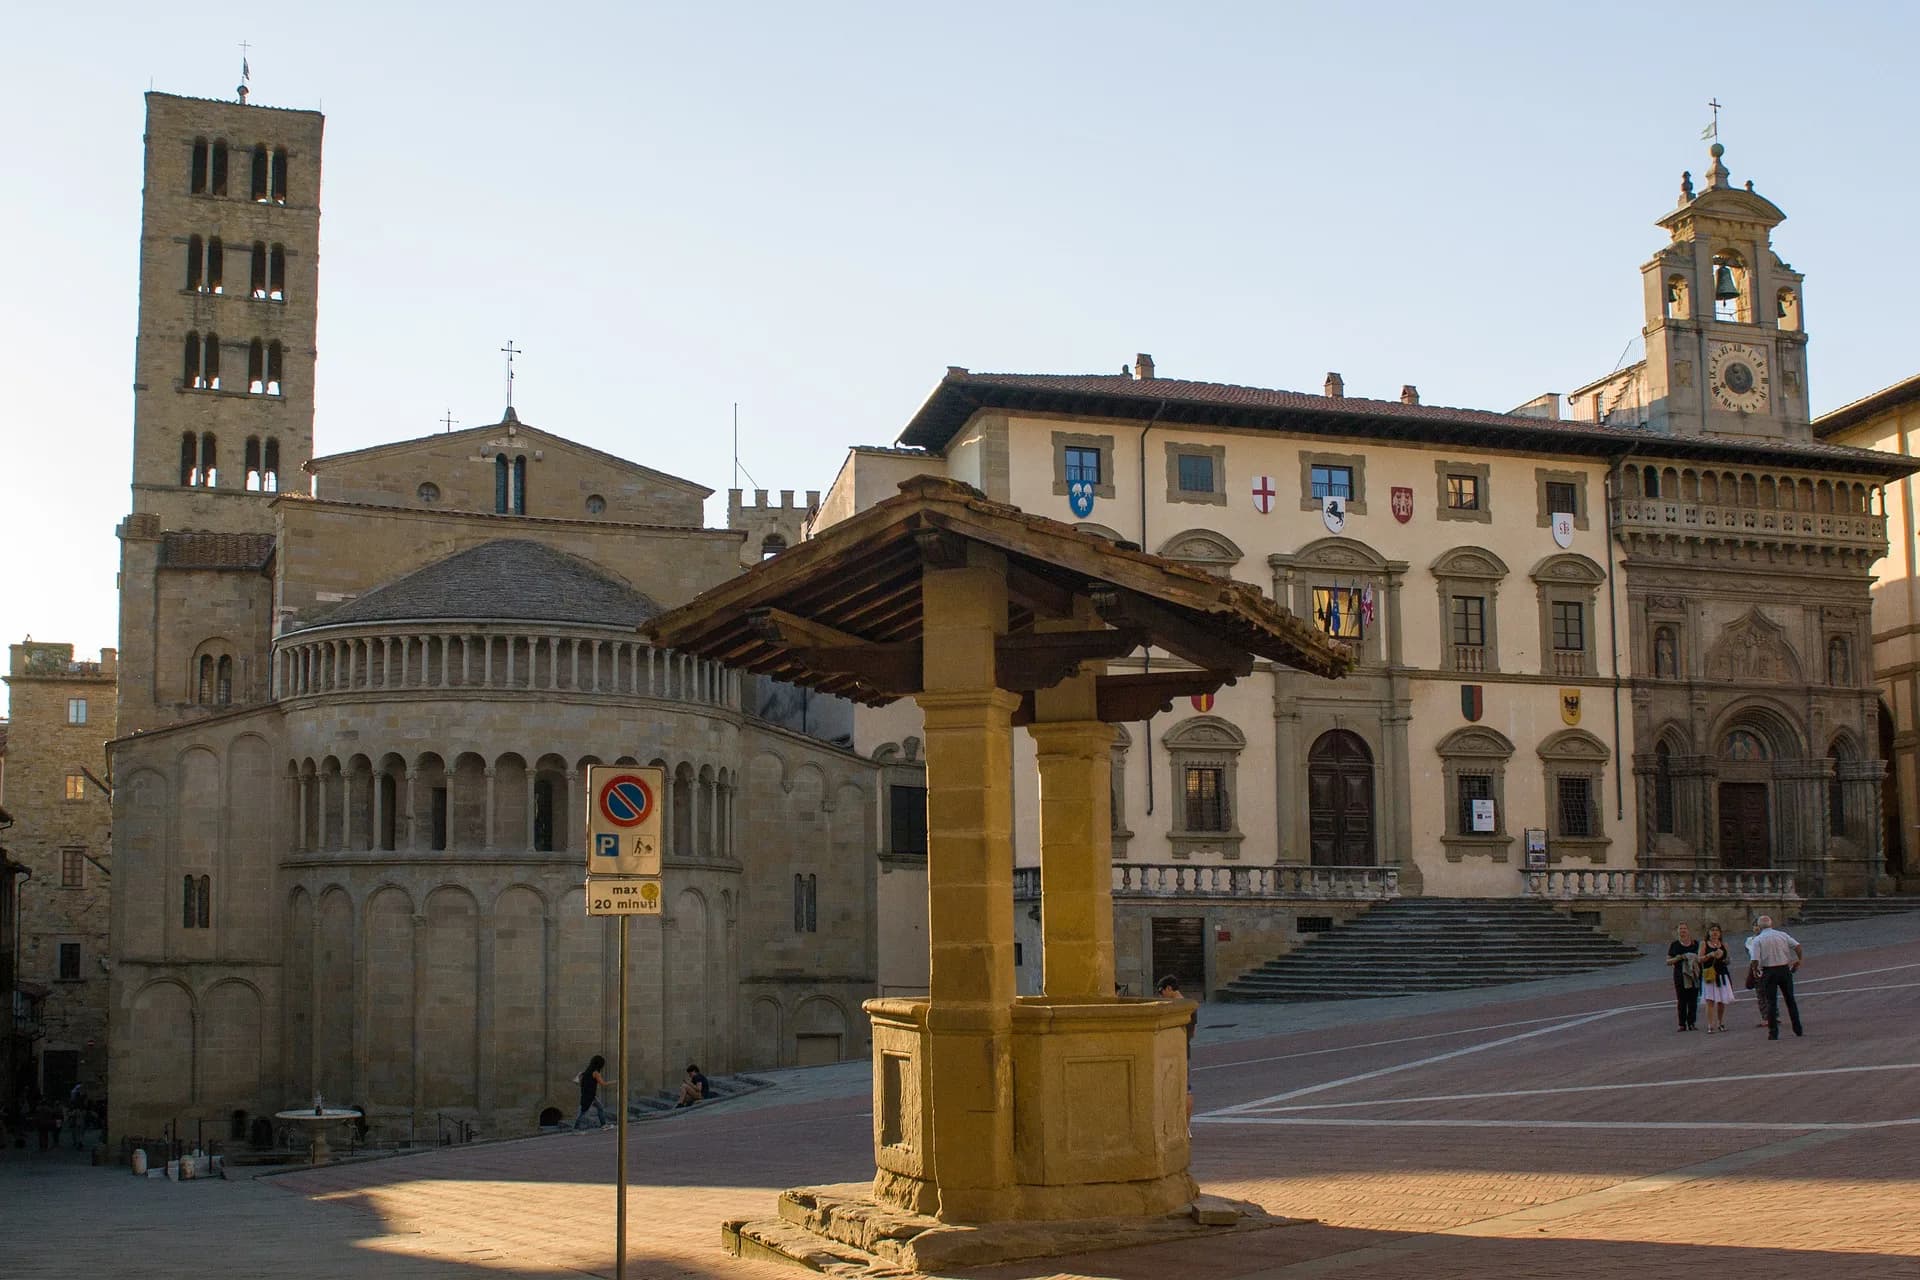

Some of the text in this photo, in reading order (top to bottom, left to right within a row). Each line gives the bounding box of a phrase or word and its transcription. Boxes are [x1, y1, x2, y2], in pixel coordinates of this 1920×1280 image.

[600, 837, 615, 854] P
[612, 886, 638, 895] max
[594, 899, 657, 909] 20 minuti
